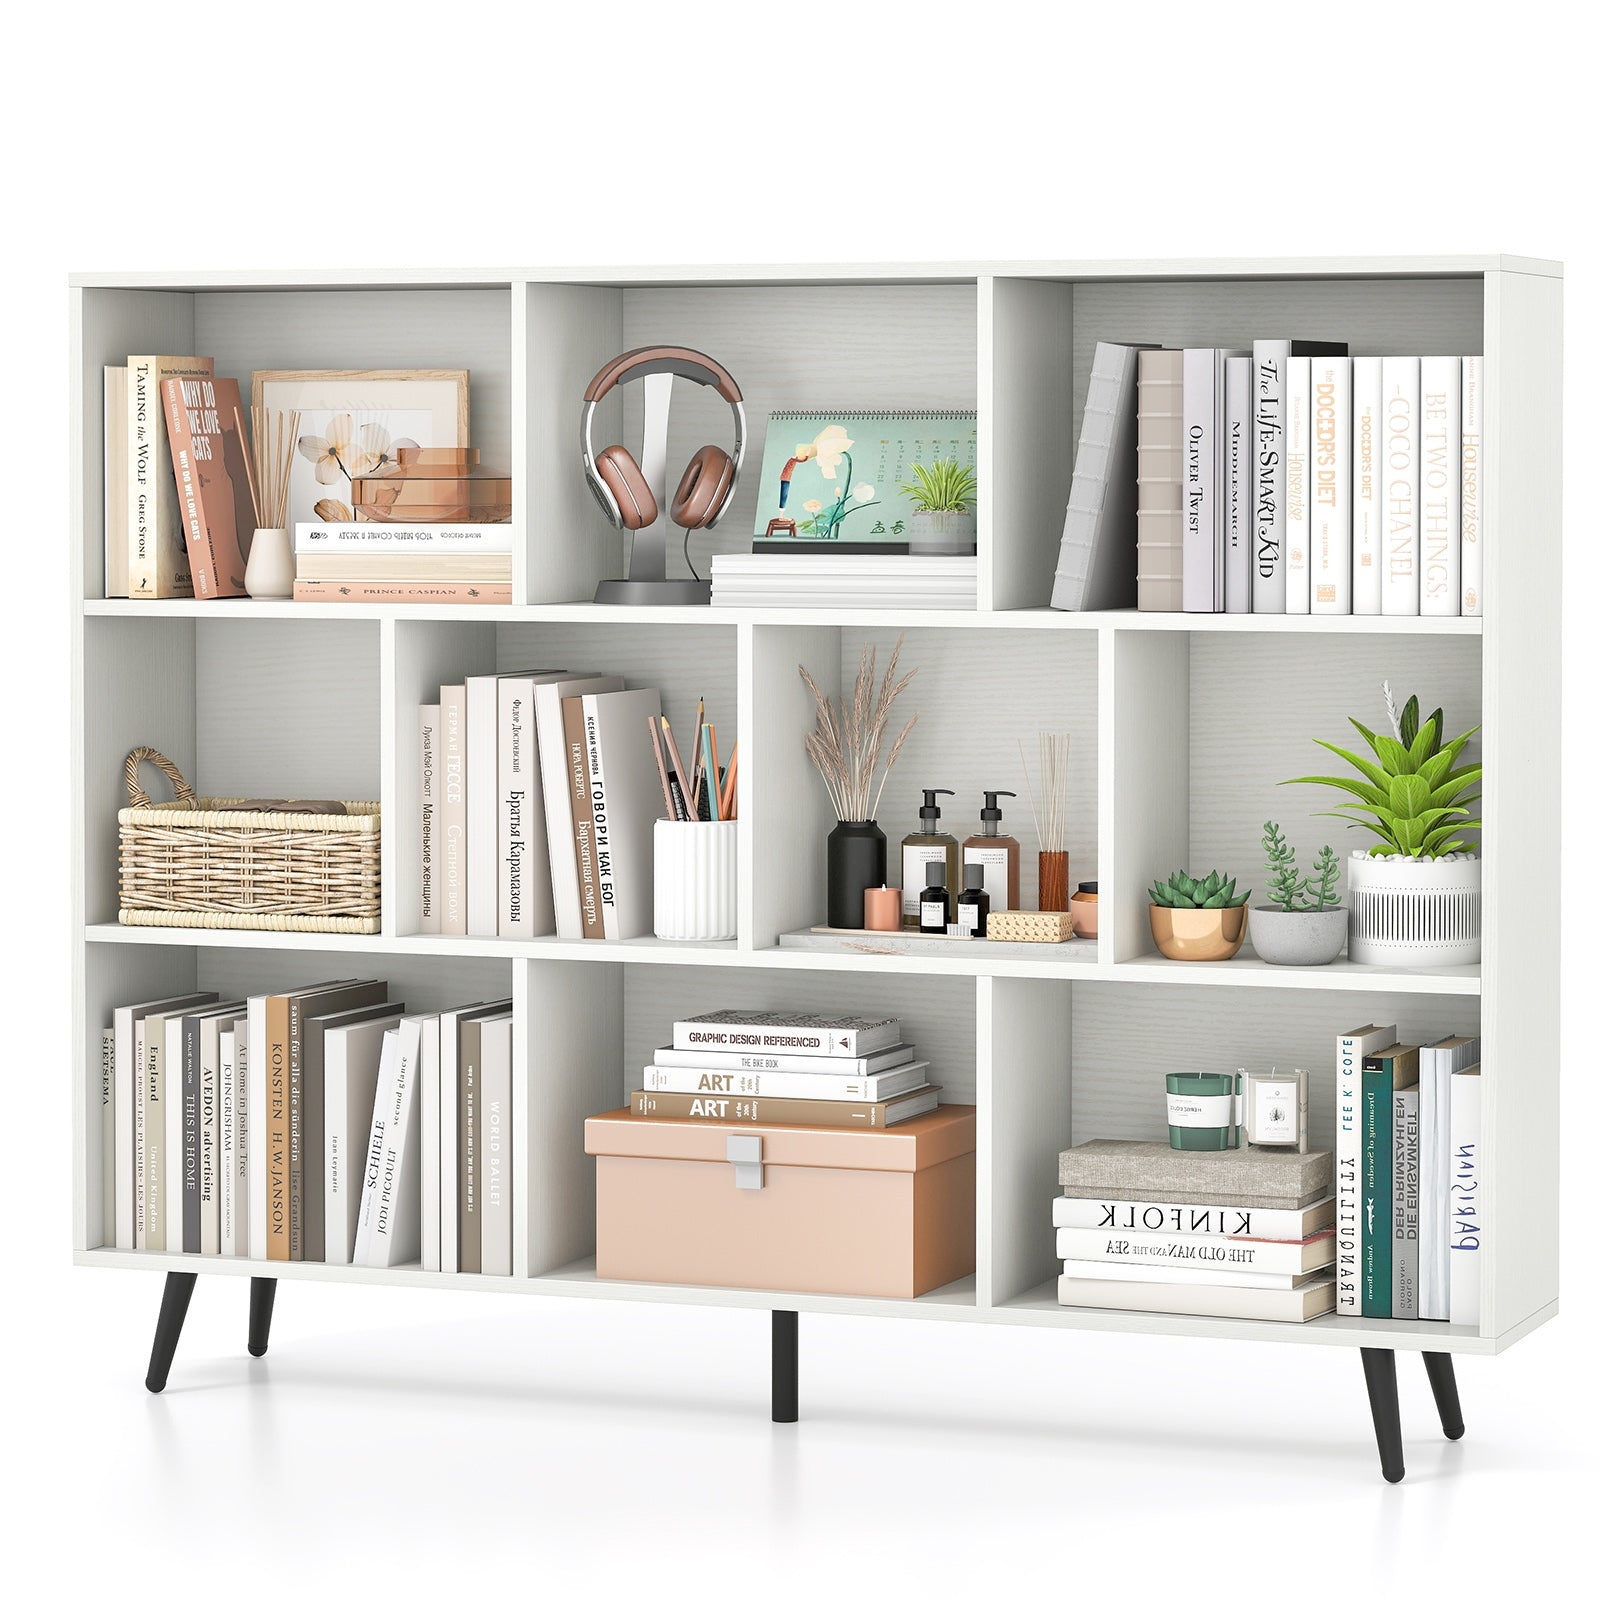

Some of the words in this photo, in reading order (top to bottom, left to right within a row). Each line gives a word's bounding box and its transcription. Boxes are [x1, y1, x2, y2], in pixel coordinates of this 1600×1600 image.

[1259, 359, 1279, 395] The
[1326, 369, 1335, 383] the
[180, 381, 200, 408] WHY
[202, 381, 216, 407] DO
[1425, 392, 1447, 420] BE
[185, 410, 202, 434] WE
[202, 409, 221, 434] LOVE
[179, 450, 188, 472] WHY
[191, 436, 212, 461] CATS
[1189, 424, 1204, 483] OLIVER
[1425, 426, 1448, 489] TWO
[183, 471, 191, 484] DO
[185, 484, 193, 498] WE
[1231, 420, 1241, 548] MIDDLEMARCH
[1288, 453, 1306, 521] Housewise
[1316, 470, 1337, 507] DIET
[1361, 475, 1373, 501] DIET
[1462, 433, 1480, 543] Housewise
[138, 495, 147, 524] GREG
[188, 496, 198, 521] LOVE
[1189, 486, 1204, 534] TWIST
[138, 526, 146, 560] STONE
[191, 520, 201, 541] CATS
[1389, 479, 1413, 583] CHANEL
[1425, 496, 1449, 598] THINGS:
[422, 726, 432, 750] Луиза
[449, 705, 458, 751] ГЕРМАН
[587, 716, 597, 746] КСЕНИЯ
[423, 751, 433, 769] Мэй
[590, 746, 599, 776] ЧЕРНОВА
[423, 769, 432, 797] Олкотт
[447, 754, 461, 803] ГЕССЕ
[505, 790, 525, 837] Братья
[591, 781, 609, 846] ГОВОРИ
[422, 803, 433, 864] Маленькие
[577, 820, 595, 883] Бархатная
[599, 851, 612, 877] КАК
[421, 864, 432, 918] женщины
[505, 840, 525, 923] Карамазовы
[601, 882, 615, 907] БОГ
[583, 885, 598, 925] смерть
[291, 1005, 299, 1036] saum
[239, 1044, 247, 1057] At
[291, 1040, 300, 1057] für
[689, 1032, 728, 1045] GRAPHIC
[729, 1034, 761, 1046] DESIGN
[763, 1035, 820, 1048] REFERENCED
[148, 1046, 159, 1102] England
[223, 1063, 232, 1095] JOHN
[239, 1062, 247, 1094] Home
[291, 1061, 299, 1083] alla
[395, 1056, 408, 1090] glance
[741, 1058, 751, 1067] THE
[752, 1058, 764, 1068] BIKE
[765, 1059, 779, 1069] BOOK
[203, 1067, 213, 1126] AVEDON
[272, 1043, 283, 1119] KONSTEN
[291, 1087, 299, 1105] die
[697, 1074, 734, 1092] ART
[186, 1093, 196, 1126] THIS
[239, 1097, 247, 1108] in
[393, 1092, 403, 1126] second
[689, 1099, 730, 1117] ART
[186, 1130, 195, 1142] IS
[224, 1096, 232, 1151] GRISHAM
[237, 1111, 248, 1149] Joshua
[291, 1109, 299, 1162] sünderin
[490, 1101, 500, 1152] WORLD
[150, 1146, 158, 1181] United
[186, 1146, 195, 1190] HOME
[202, 1130, 213, 1202] advertising
[239, 1153, 248, 1178] Tree
[367, 1120, 385, 1189] SCHIELE
[330, 1156, 338, 1193] Leymarie
[381, 1147, 396, 1203] PICOULT
[490, 1158, 501, 1207] BALLET
[149, 1184, 158, 1232] Kingdom
[377, 1205, 389, 1235] JODI
